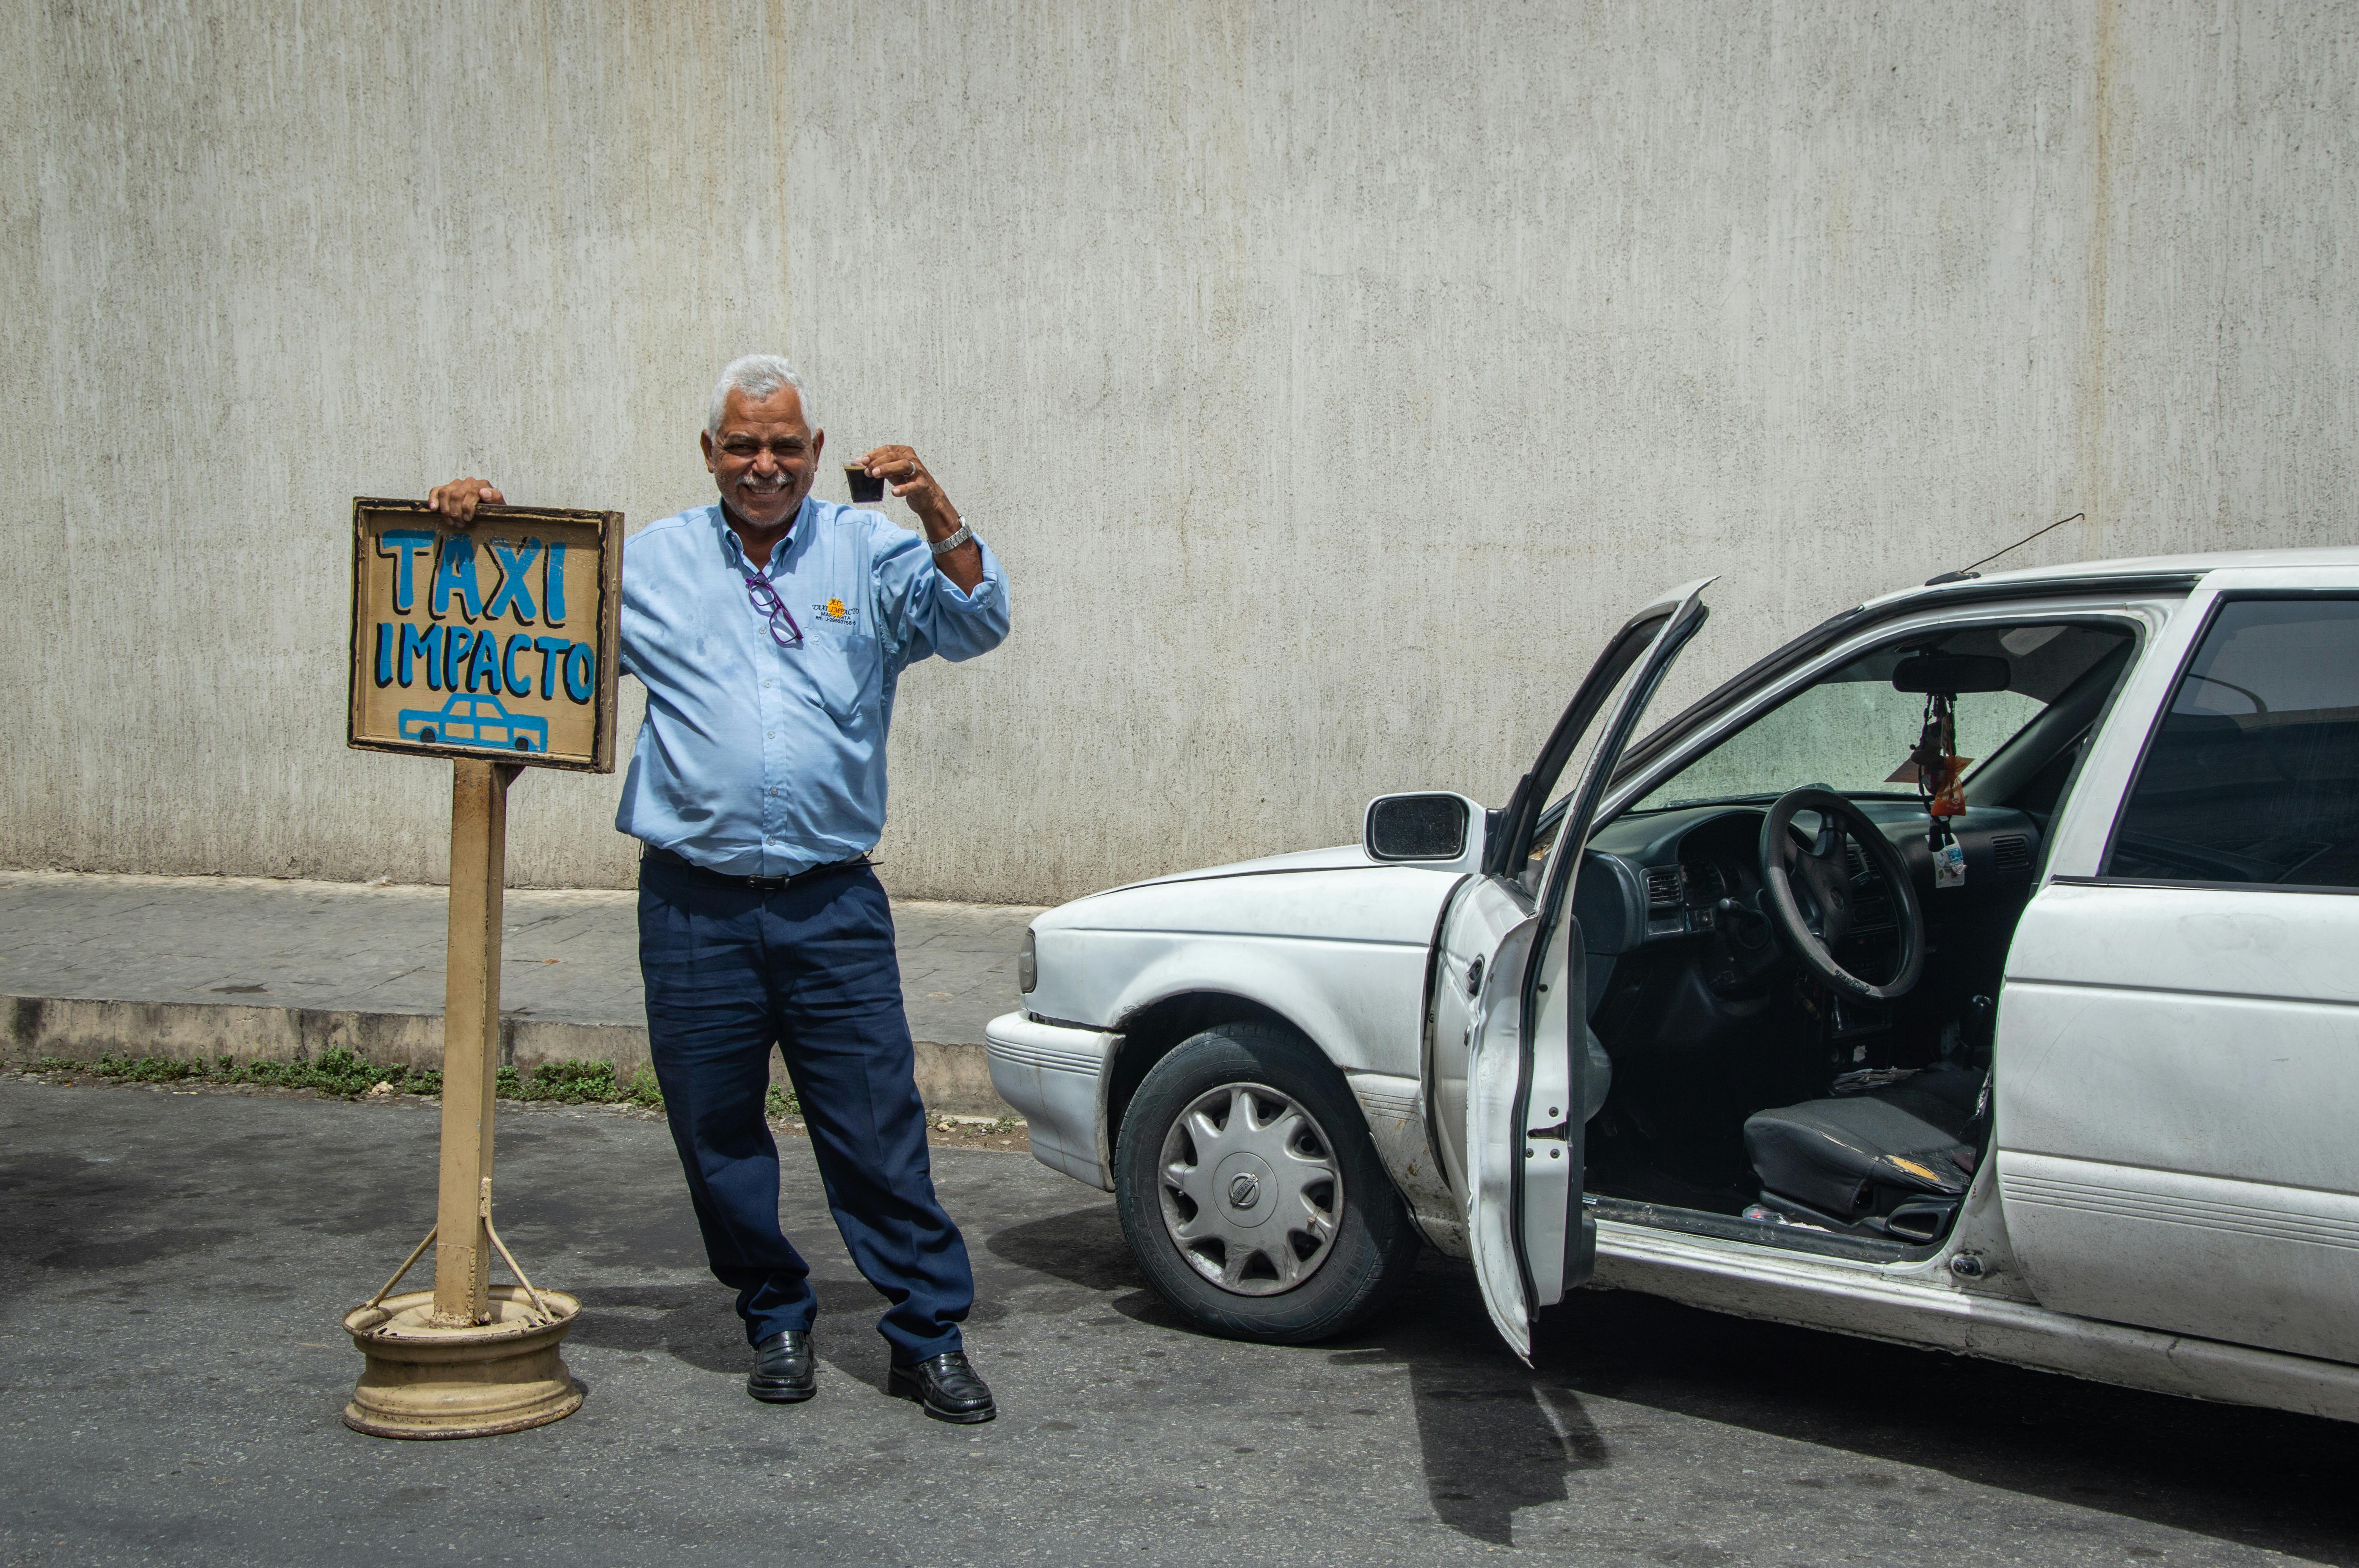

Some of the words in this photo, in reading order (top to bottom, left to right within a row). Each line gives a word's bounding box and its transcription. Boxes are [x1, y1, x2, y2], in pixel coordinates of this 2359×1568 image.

[376, 529, 566, 628] TAXI
[821, 612, 851, 621] MARGARITA
[830, 607, 859, 615] IMPACTO
[374, 622, 594, 705] IMPACTO
[1233, 1178, 1254, 1203] NISSAN
